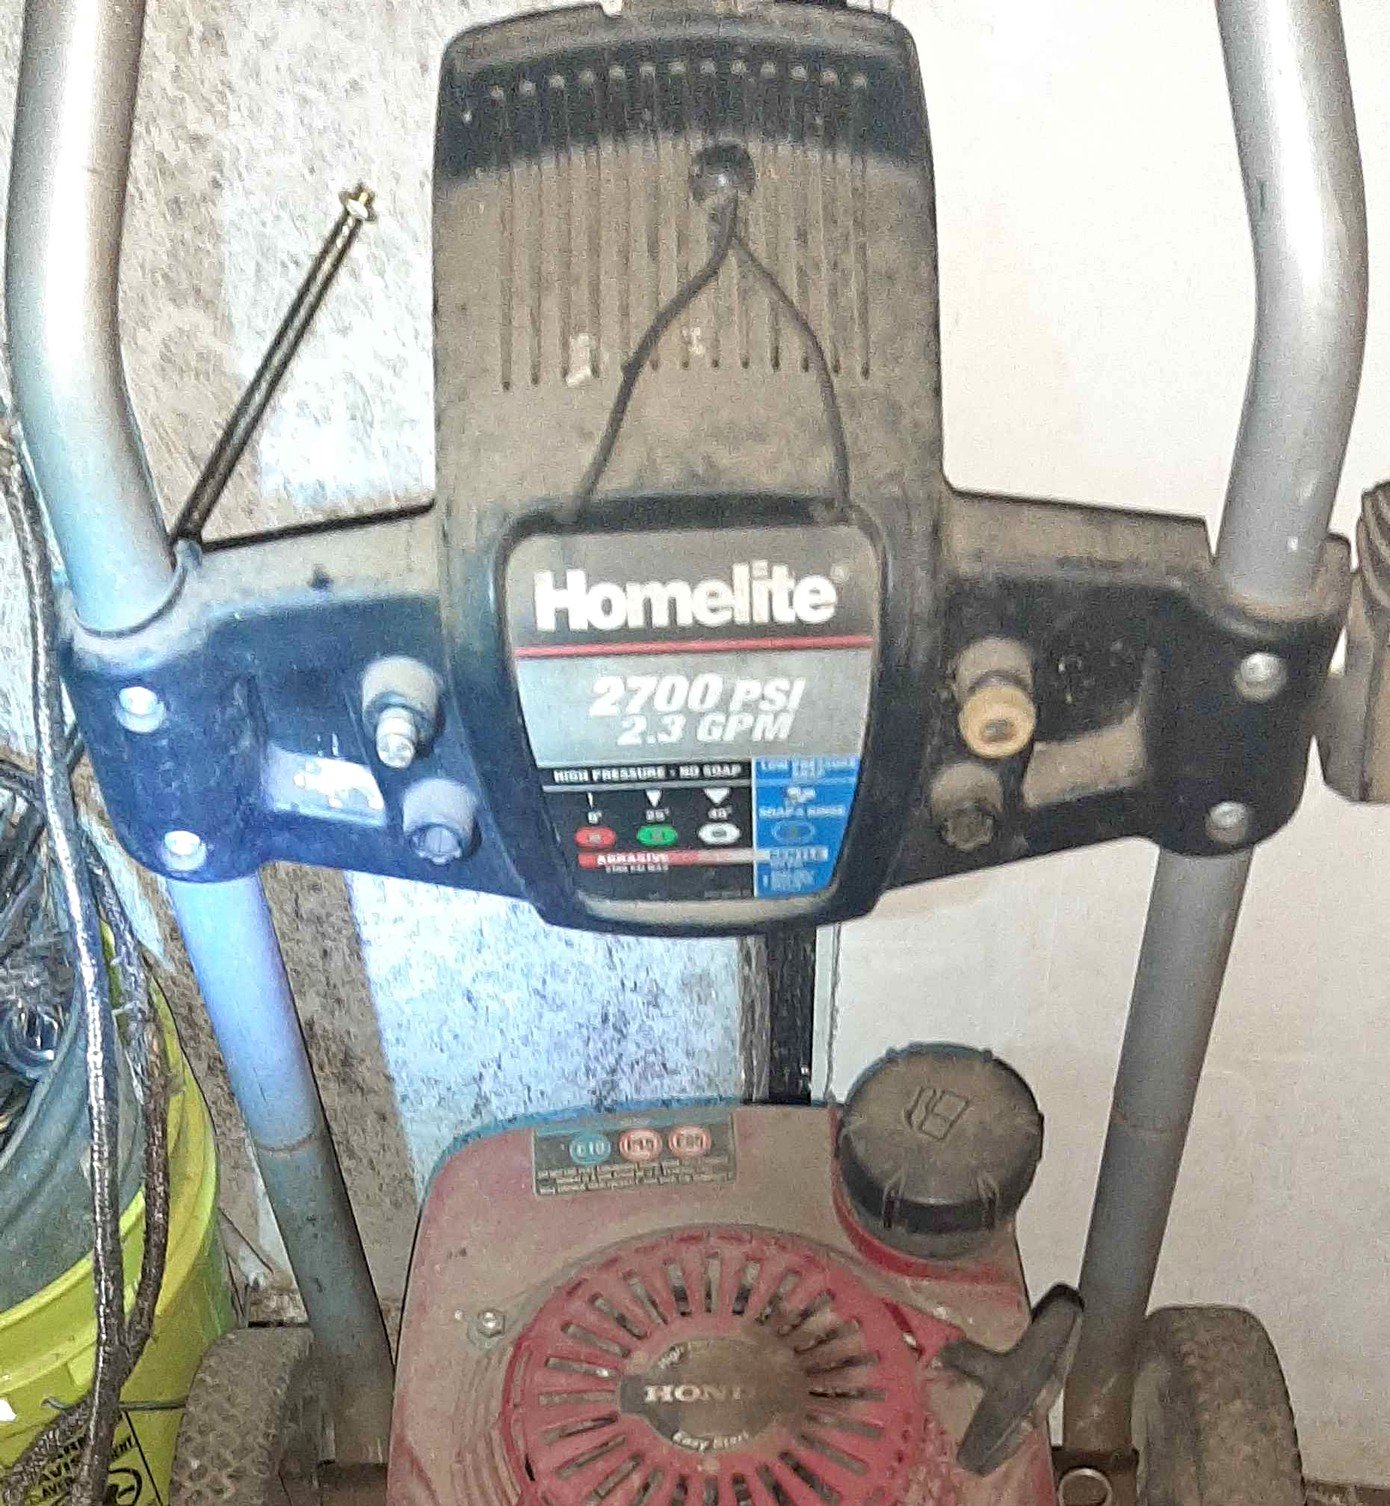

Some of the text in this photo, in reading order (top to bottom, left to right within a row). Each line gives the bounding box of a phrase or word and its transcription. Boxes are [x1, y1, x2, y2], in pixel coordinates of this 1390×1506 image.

[534, 560, 838, 632] Homelite
[588, 672, 806, 717] 2700 PSI
[616, 711, 797, 747] 2.3 GPM
[553, 768, 589, 783] HIGH
[592, 765, 666, 782] PRESSURE
[703, 763, 742, 778] SOAP
